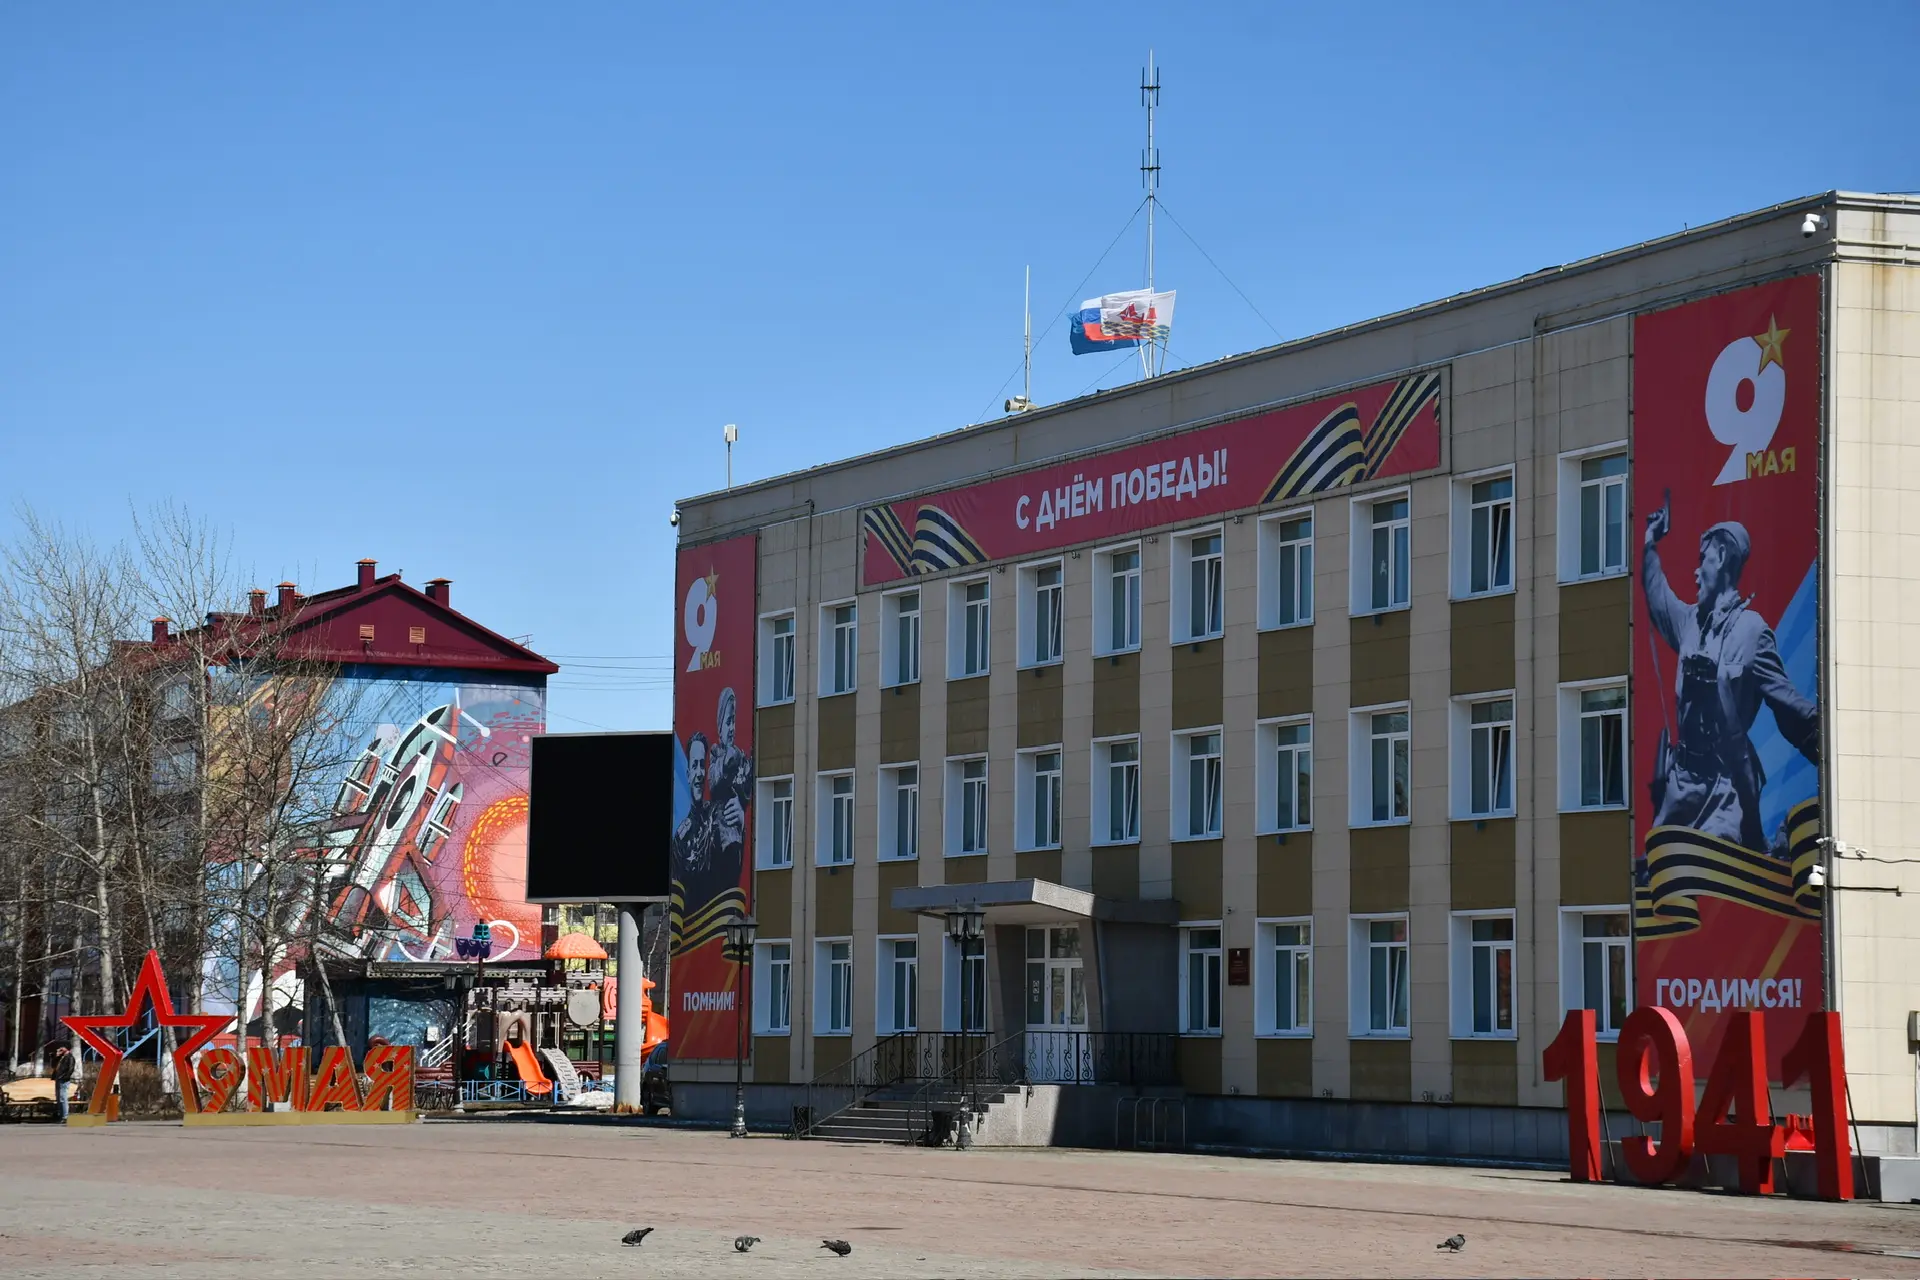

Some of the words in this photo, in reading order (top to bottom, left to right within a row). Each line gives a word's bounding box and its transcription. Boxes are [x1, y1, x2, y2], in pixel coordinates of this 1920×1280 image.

[1705, 336, 1785, 486] 9
[1015, 494, 1031, 530] С
[1035, 473, 1104, 533] ДНЁМ
[1110, 448, 1228, 510] ПОБЕДЫ!
[1746, 447, 1796, 479] МАЯ
[684, 577, 718, 673] 9
[700, 650, 721, 669] МАЯ
[683, 991, 735, 1012] ПОМНИМ!
[1656, 978, 1802, 1014] ГОРДИМСЯ!
[197, 1048, 246, 1114] 9
[248, 1045, 415, 1113] МАЯ
[1543, 1006, 1855, 1201] 1941
